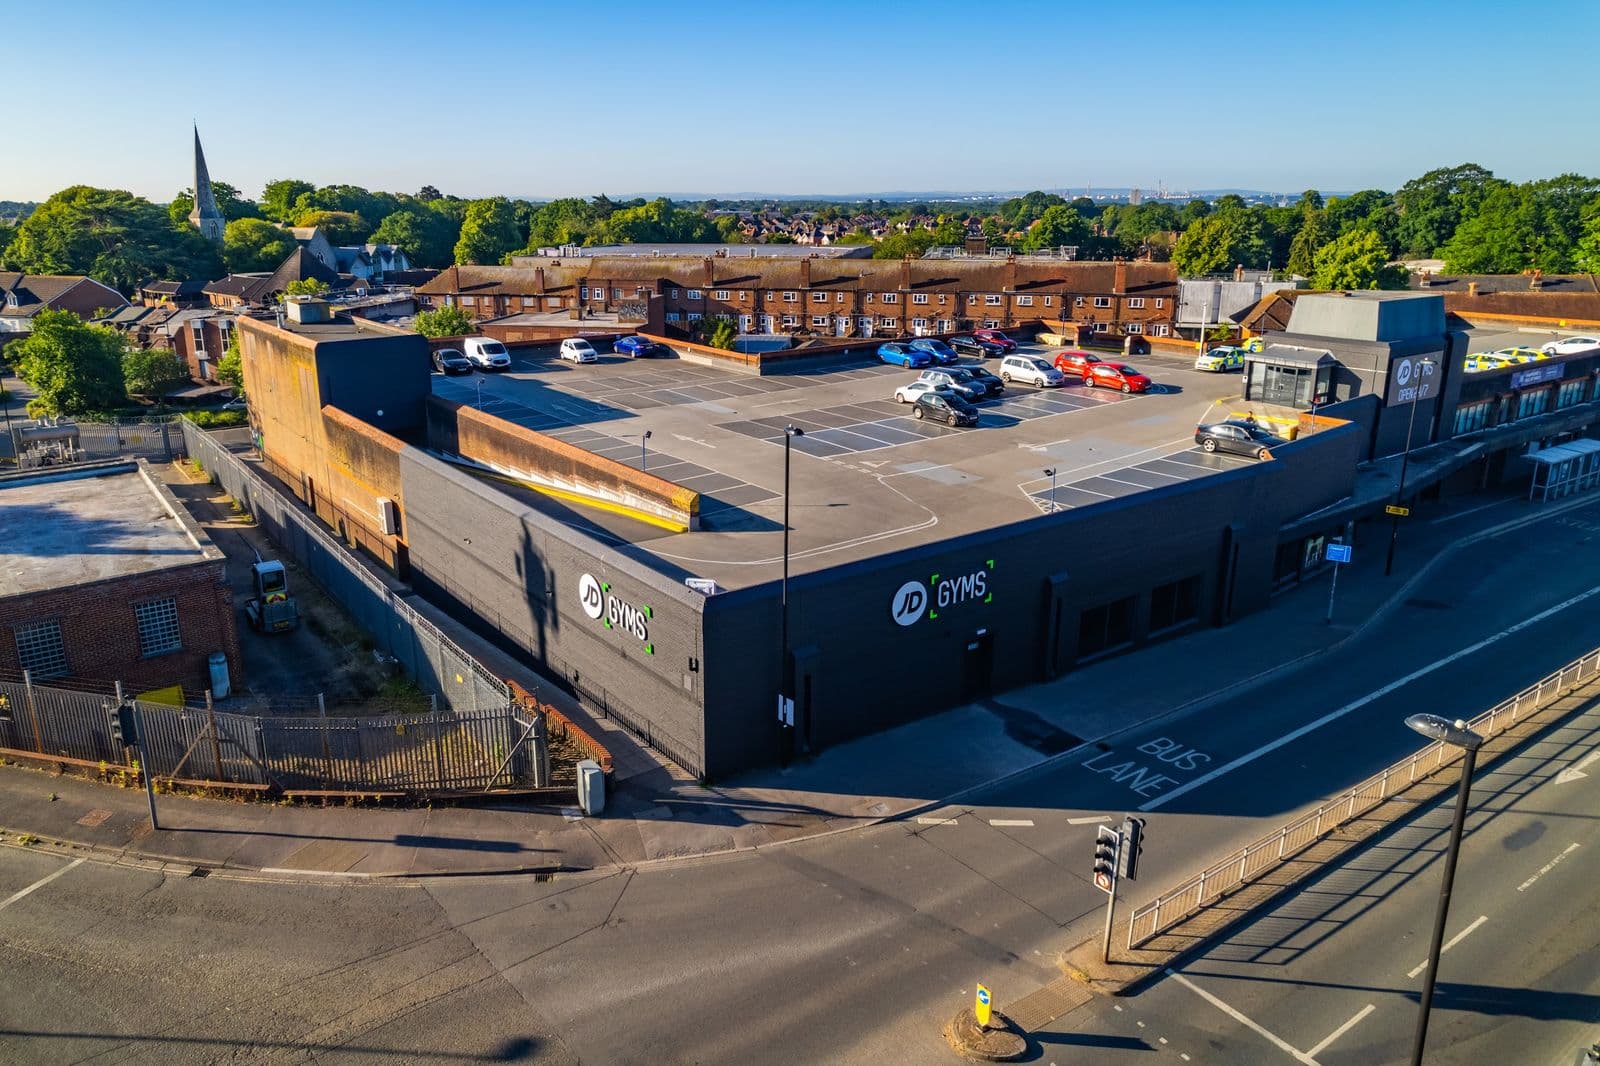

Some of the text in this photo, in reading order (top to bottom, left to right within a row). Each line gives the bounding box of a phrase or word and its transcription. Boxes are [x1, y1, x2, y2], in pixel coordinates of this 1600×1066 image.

[1398, 387, 1417, 401] OPEN
[938, 571, 986, 607] GYMS
[608, 595, 646, 641] GYMS
[1136, 737, 1211, 770] BUS
[1081, 751, 1180, 797] LANE
